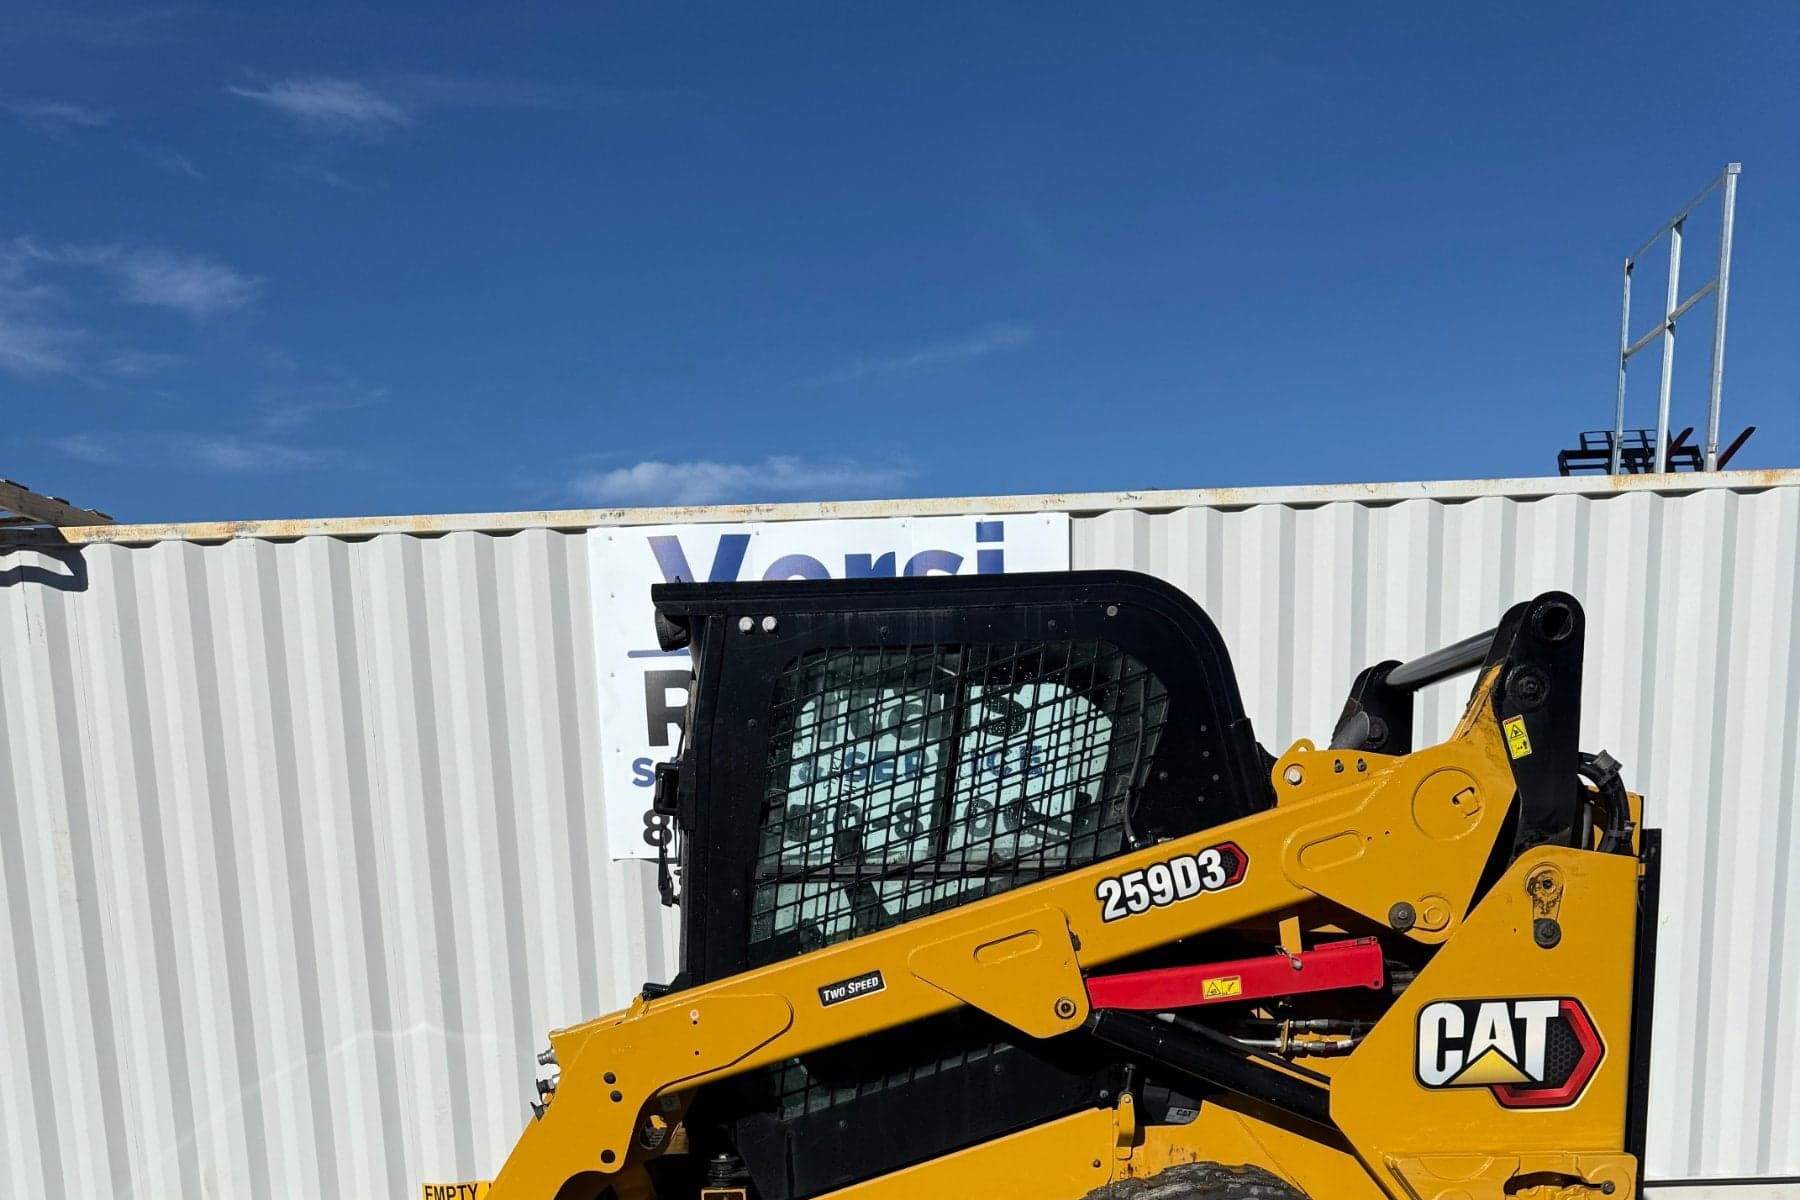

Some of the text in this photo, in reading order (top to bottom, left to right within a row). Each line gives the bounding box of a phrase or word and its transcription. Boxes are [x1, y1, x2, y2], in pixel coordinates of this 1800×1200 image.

[845, 745, 1043, 783] SERICE
[1098, 848, 1226, 921] 259D3
[1419, 999, 1560, 1087] CAT
